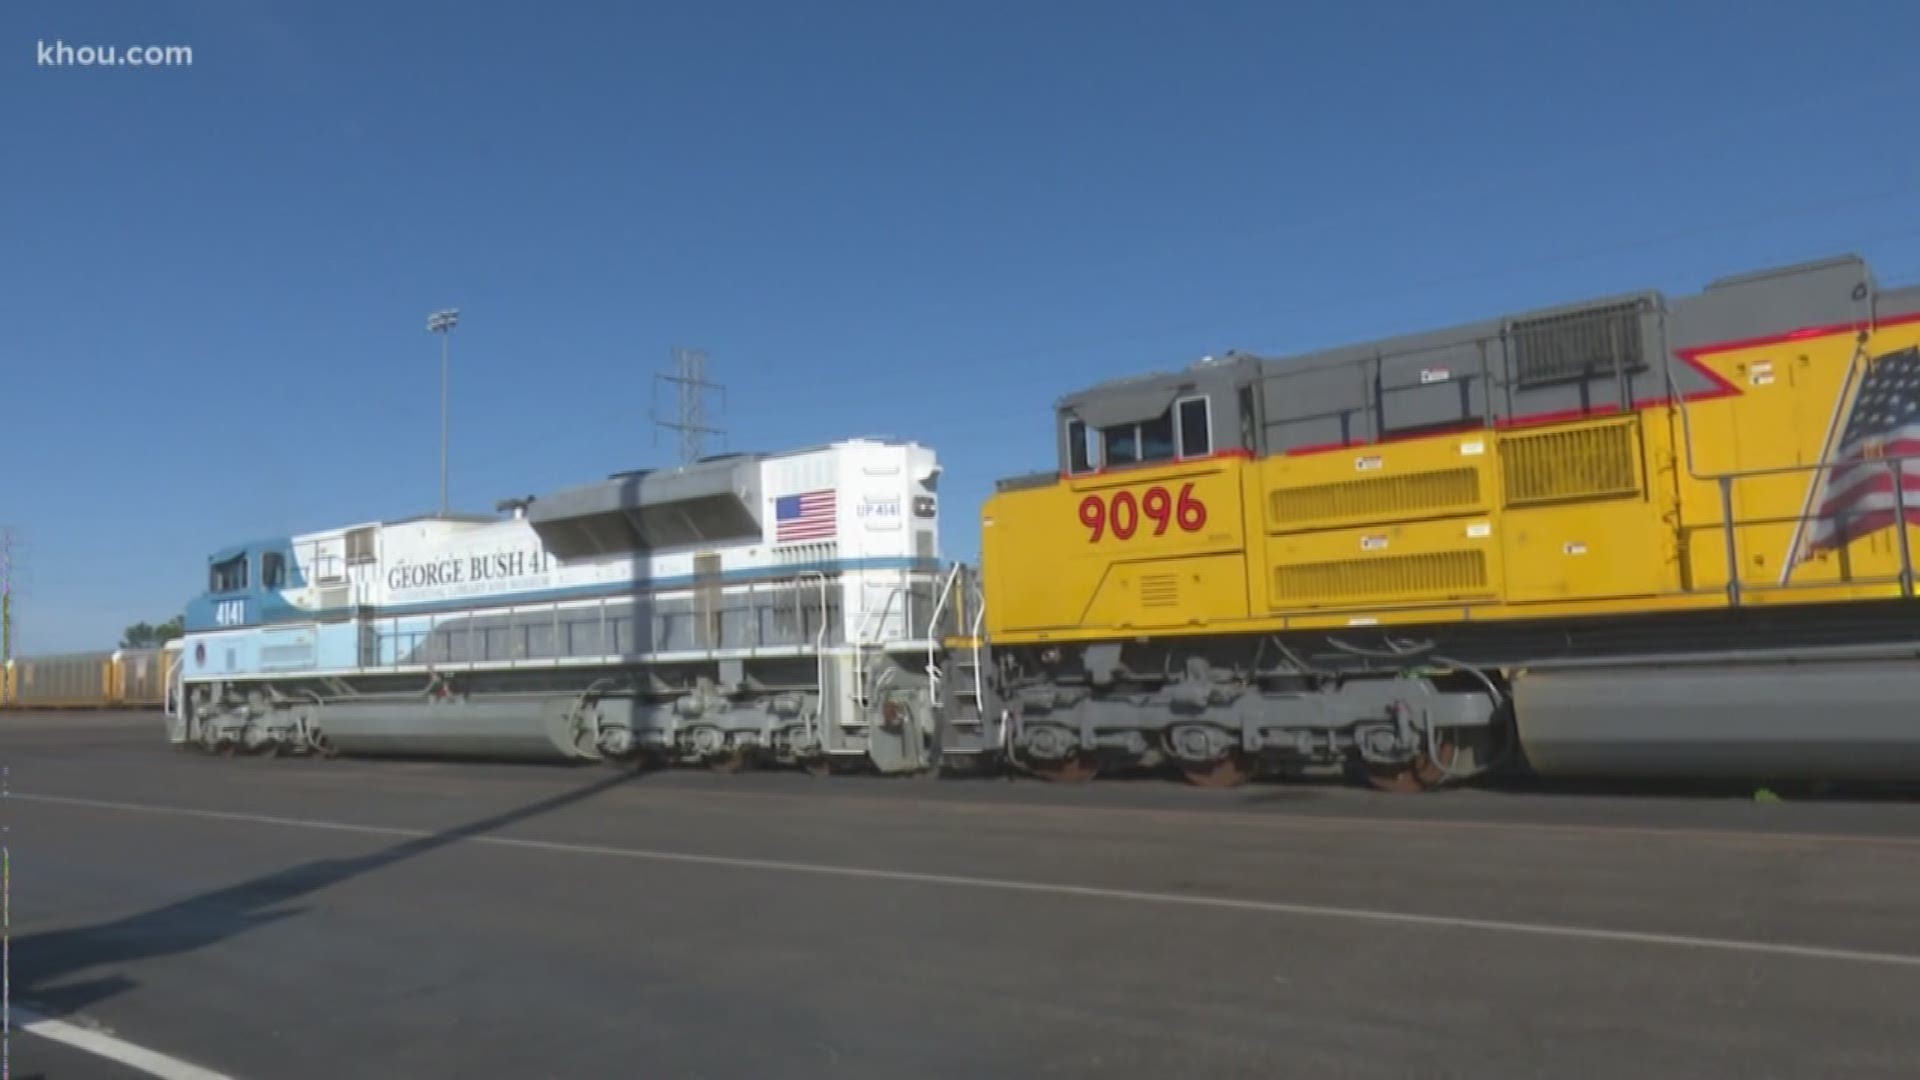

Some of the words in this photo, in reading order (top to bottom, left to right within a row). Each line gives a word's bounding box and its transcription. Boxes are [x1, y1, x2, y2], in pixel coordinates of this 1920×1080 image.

[856, 504, 874, 518] UP
[875, 503, 901, 517] 4141
[1078, 482, 1207, 543] 9096
[388, 558, 465, 590] GEORGE
[470, 550, 524, 582] BUSH
[529, 544, 549, 574] 41
[215, 600, 245, 625] 4141
